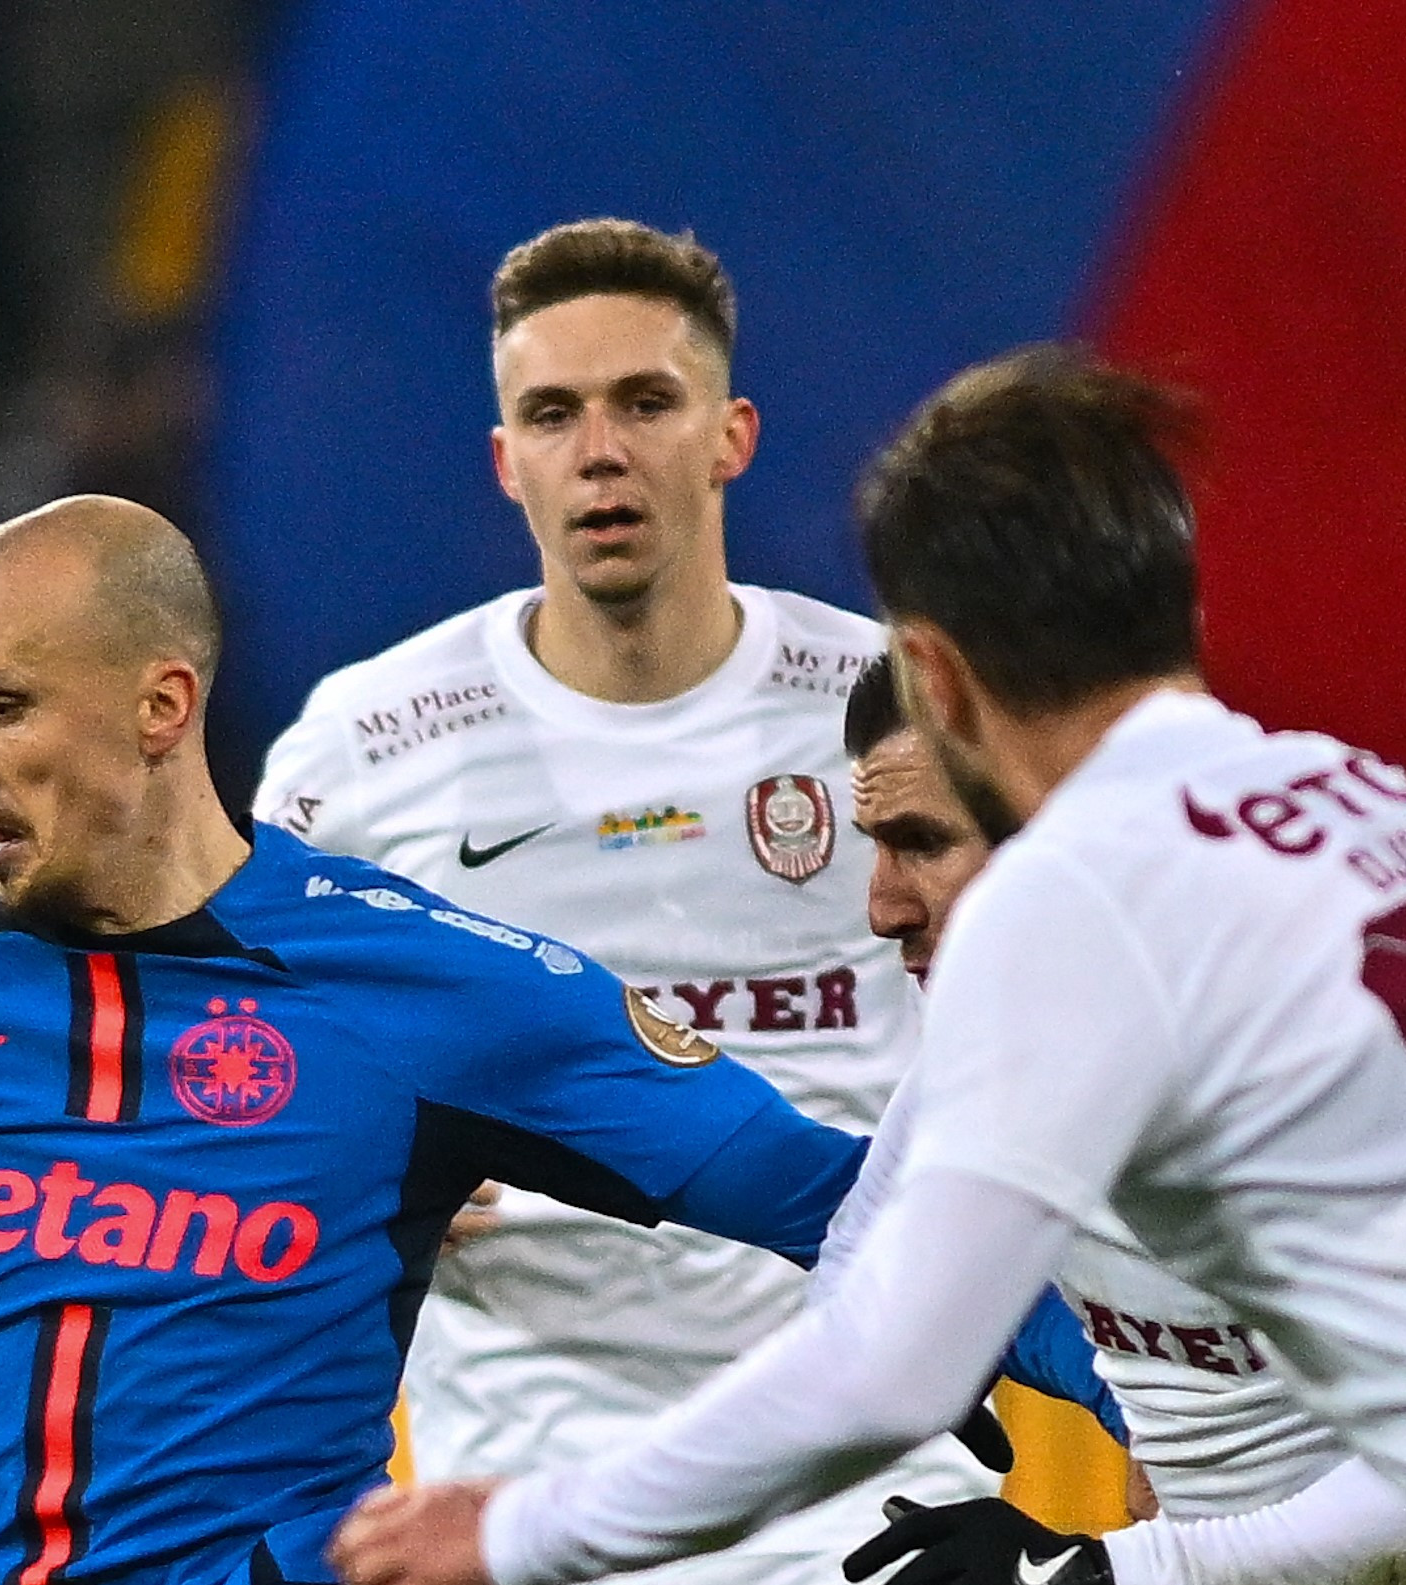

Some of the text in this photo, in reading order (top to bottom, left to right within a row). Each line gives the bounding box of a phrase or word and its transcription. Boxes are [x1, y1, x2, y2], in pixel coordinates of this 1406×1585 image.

[356, 683, 496, 741] My Place
[366, 704, 508, 764] Residence
